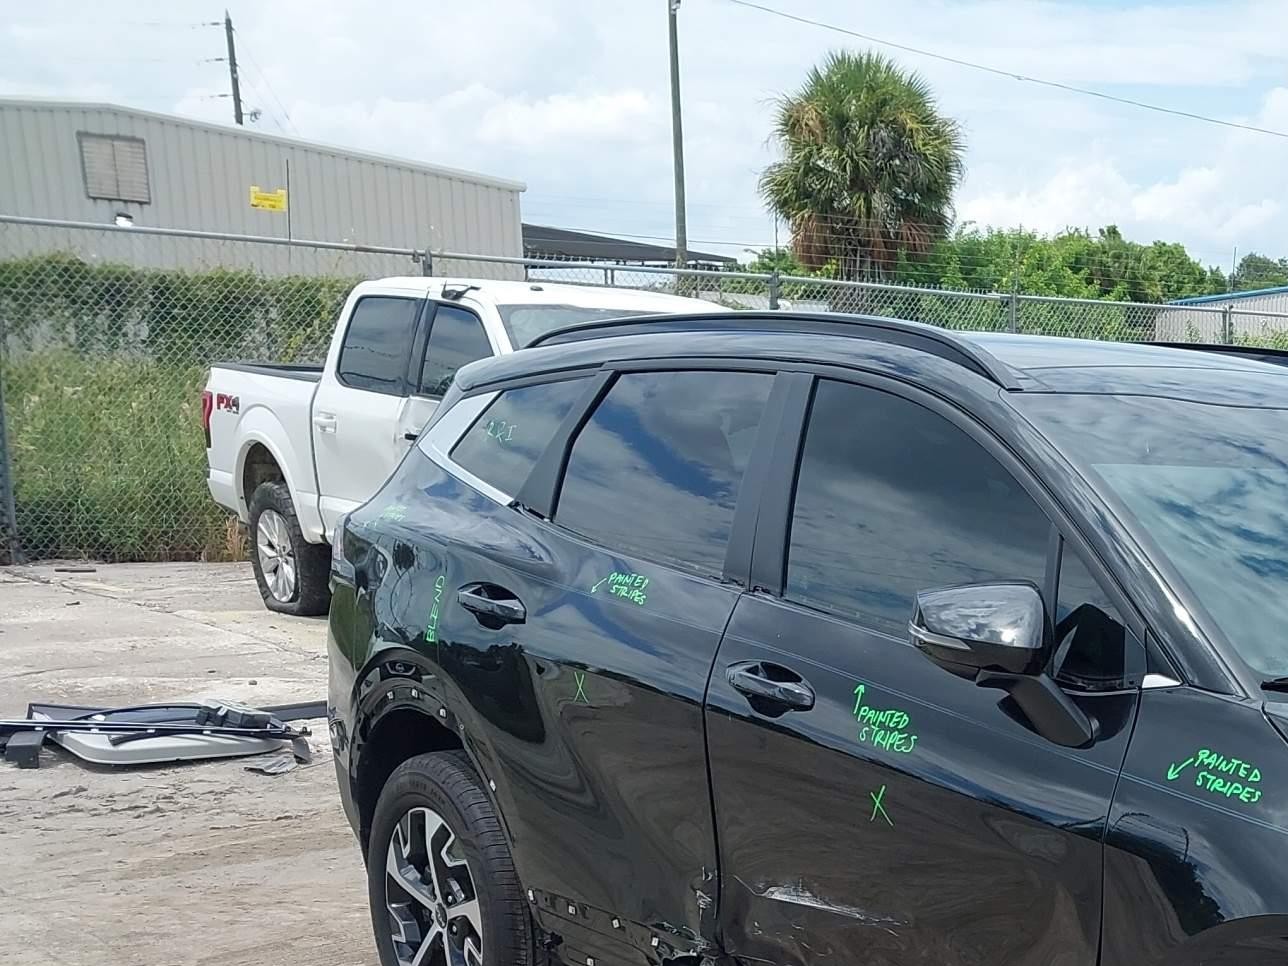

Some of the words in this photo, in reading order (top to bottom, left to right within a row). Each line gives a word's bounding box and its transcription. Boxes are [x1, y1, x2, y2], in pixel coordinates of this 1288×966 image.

[216, 393, 240, 411] FX4
[608, 572, 649, 591] PAINTED
[609, 584, 647, 605] STRIPES
[425, 574, 446, 642] BLEND
[857, 706, 910, 729] PAINTED
[859, 725, 918, 752] STRIPES
[1194, 749, 1261, 782] PAINTED
[1195, 771, 1262, 803] STRIPES
